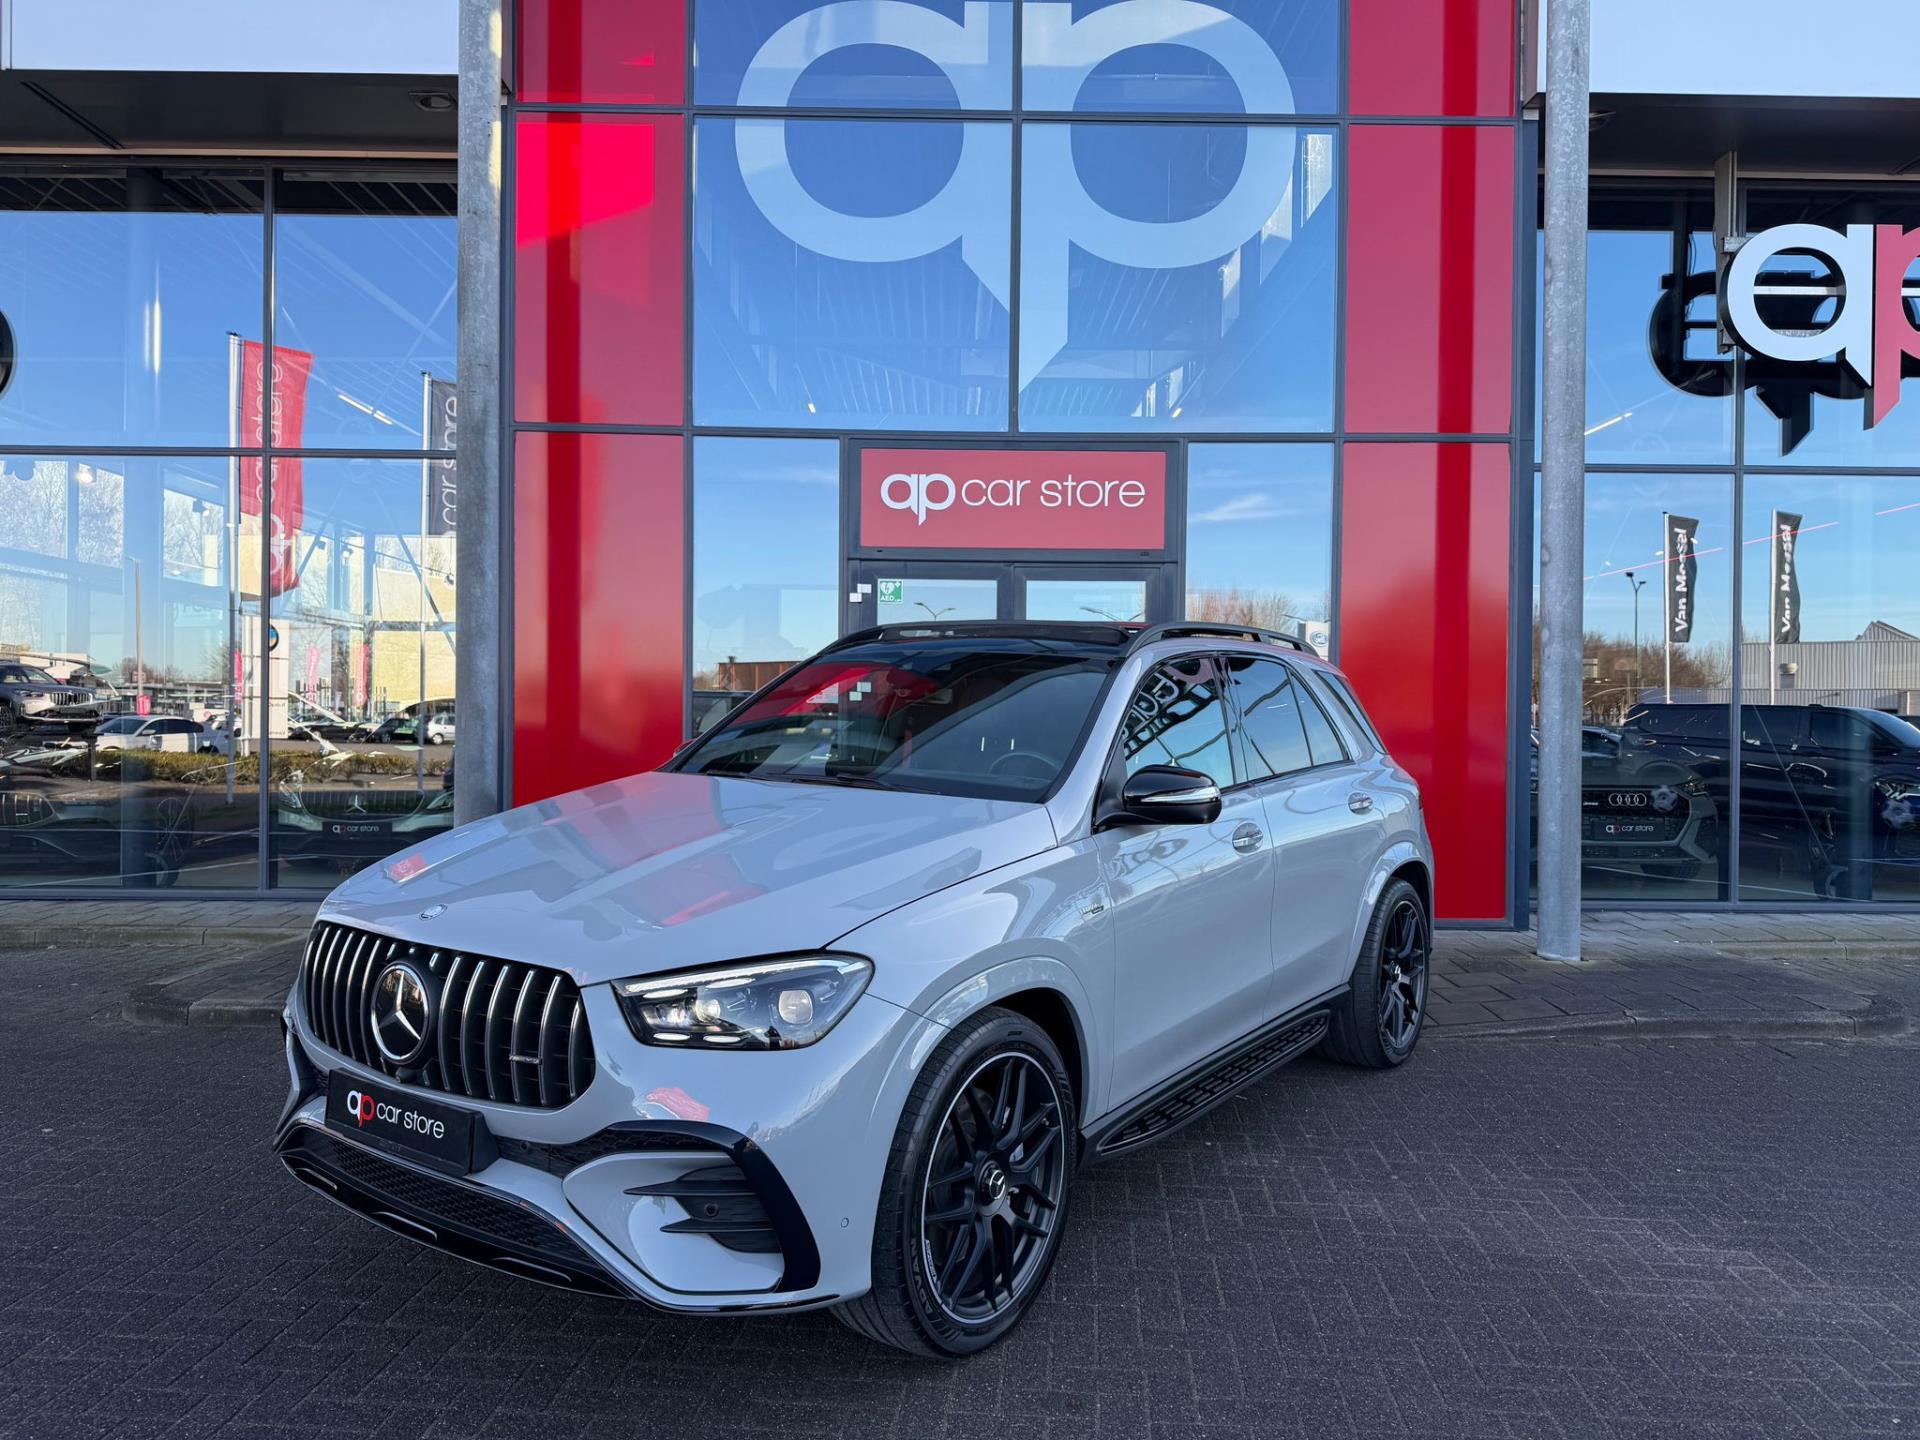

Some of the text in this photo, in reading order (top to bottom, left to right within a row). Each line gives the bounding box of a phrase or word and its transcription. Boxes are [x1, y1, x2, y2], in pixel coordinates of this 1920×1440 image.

[961, 479, 1031, 507] car
[1040, 474, 1146, 508] store
[1675, 597, 1689, 632] Van
[1781, 597, 1792, 633] Van
[360, 824, 380, 832] store
[1634, 824, 1655, 832] store
[376, 1102, 402, 1125] car
[403, 1110, 445, 1139] store
